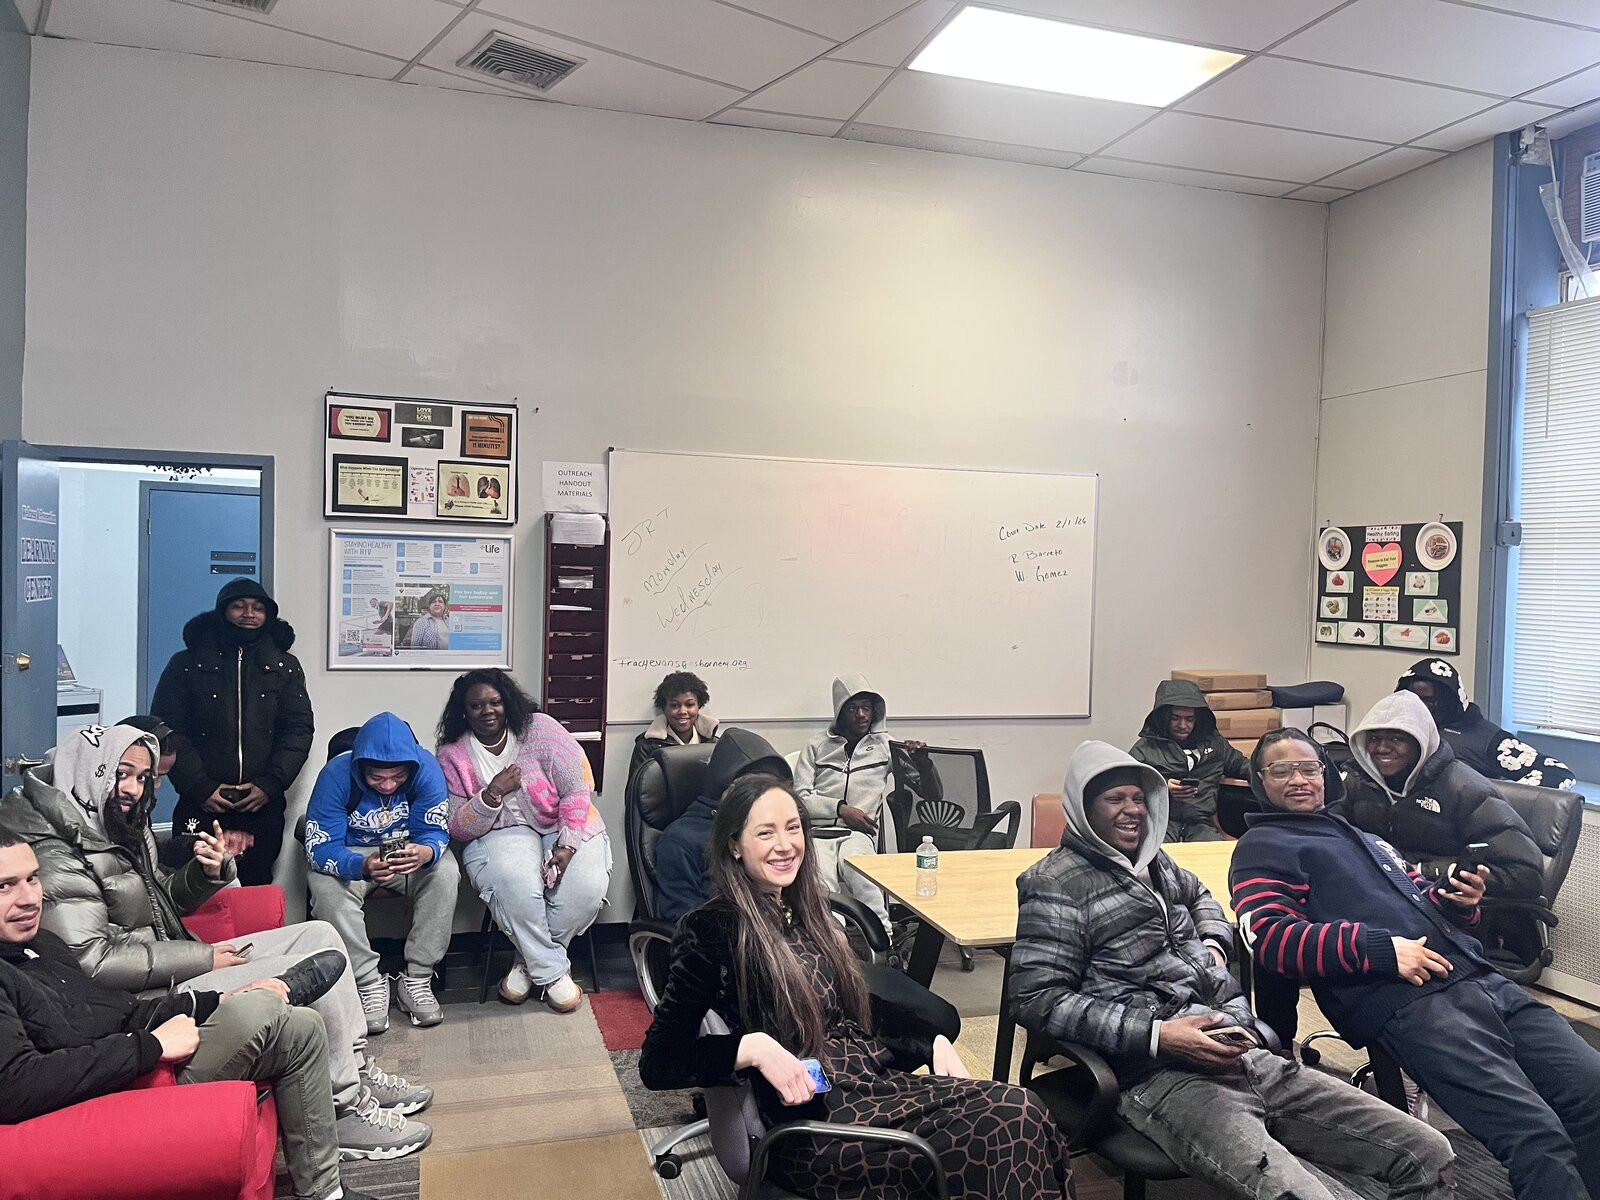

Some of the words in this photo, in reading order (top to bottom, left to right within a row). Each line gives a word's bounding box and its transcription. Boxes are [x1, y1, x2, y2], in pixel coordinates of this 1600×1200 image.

[557, 470, 593, 478] OUTREACH
[557, 490, 593, 498] MATERIALS
[344, 540, 367, 548] STAYING
[368, 541, 392, 549] HEALTHY
[20, 537, 56, 564] LEARNING
[360, 548, 372, 556] HIV
[1035, 565, 1069, 582] Gomez
[24, 575, 53, 603] CENTER
